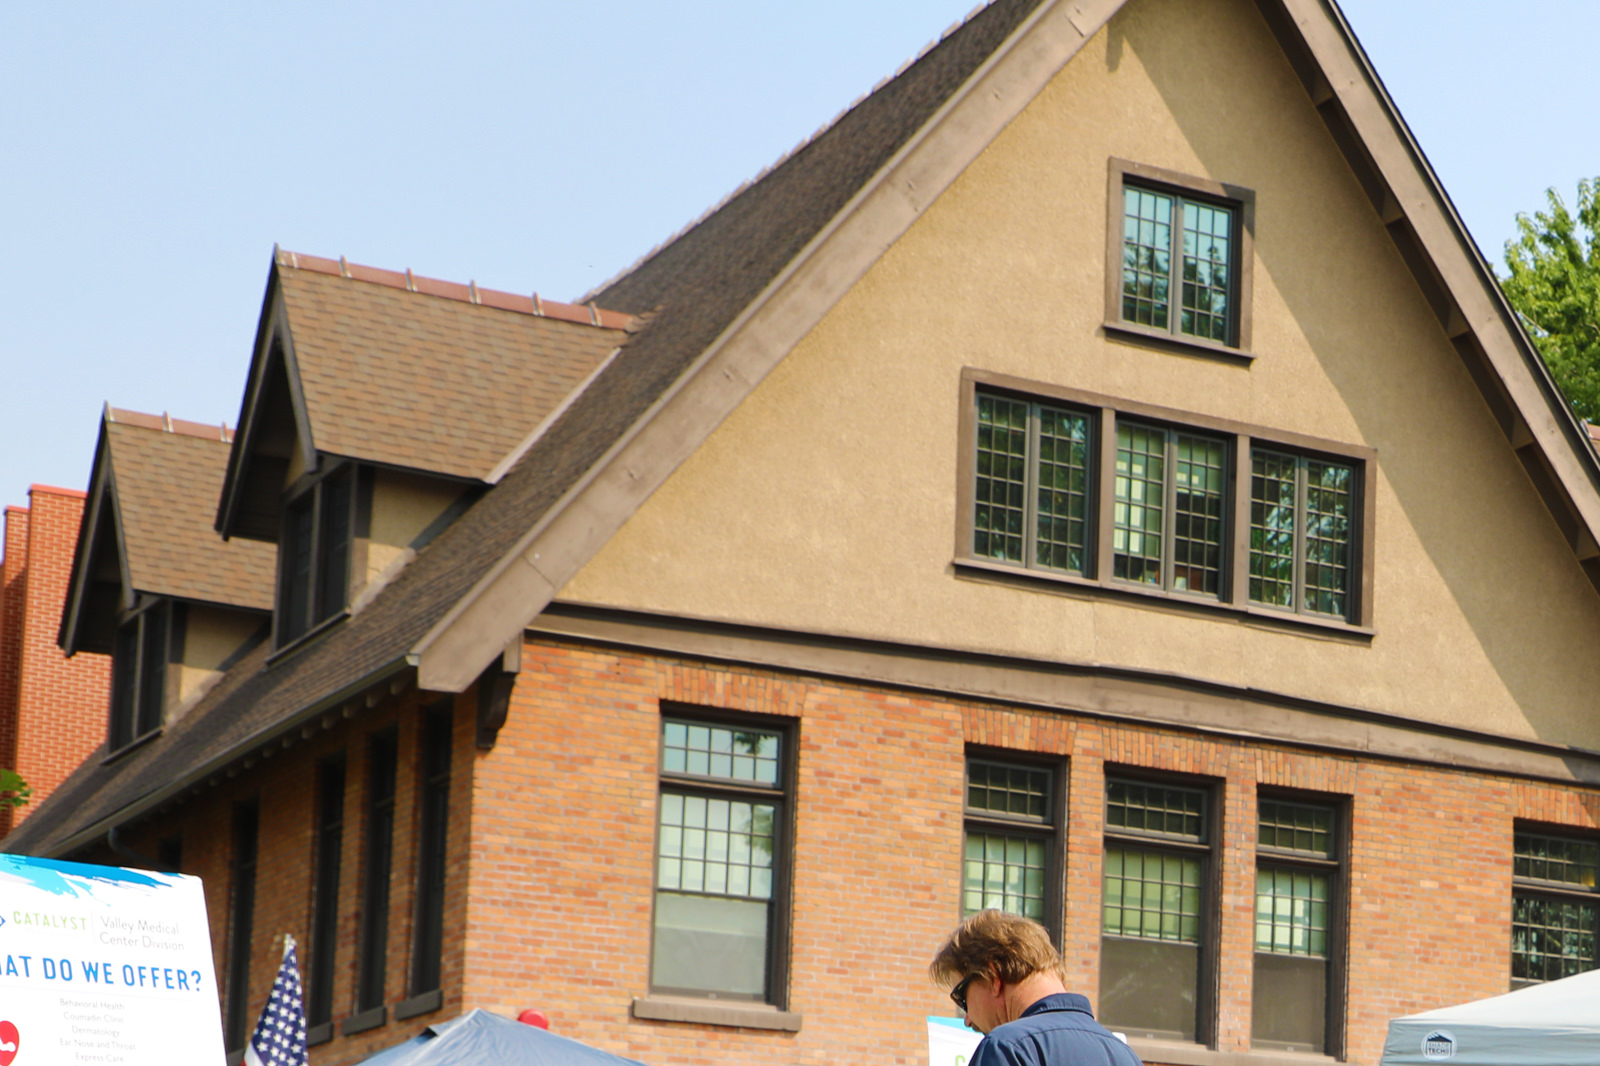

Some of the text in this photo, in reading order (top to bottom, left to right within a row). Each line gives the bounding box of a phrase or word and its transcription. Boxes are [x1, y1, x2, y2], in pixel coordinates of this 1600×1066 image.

[13, 910, 87, 930] CATALYST
[100, 914, 134, 934] Valley
[138, 920, 180, 935] Medical
[99, 931, 139, 947] Center
[142, 935, 185, 951] Division
[0, 954, 202, 992] AT DO WE OFFER?
[59, 998, 125, 1011] Behavioral Health
[103, 1013, 124, 1024] Clinic
[72, 1025, 120, 1038] Dermatology
[74, 1039, 94, 1049] Nose
[96, 1040, 110, 1050] and
[111, 1041, 136, 1051] Throat
[75, 1052, 124, 1064] Express Care
